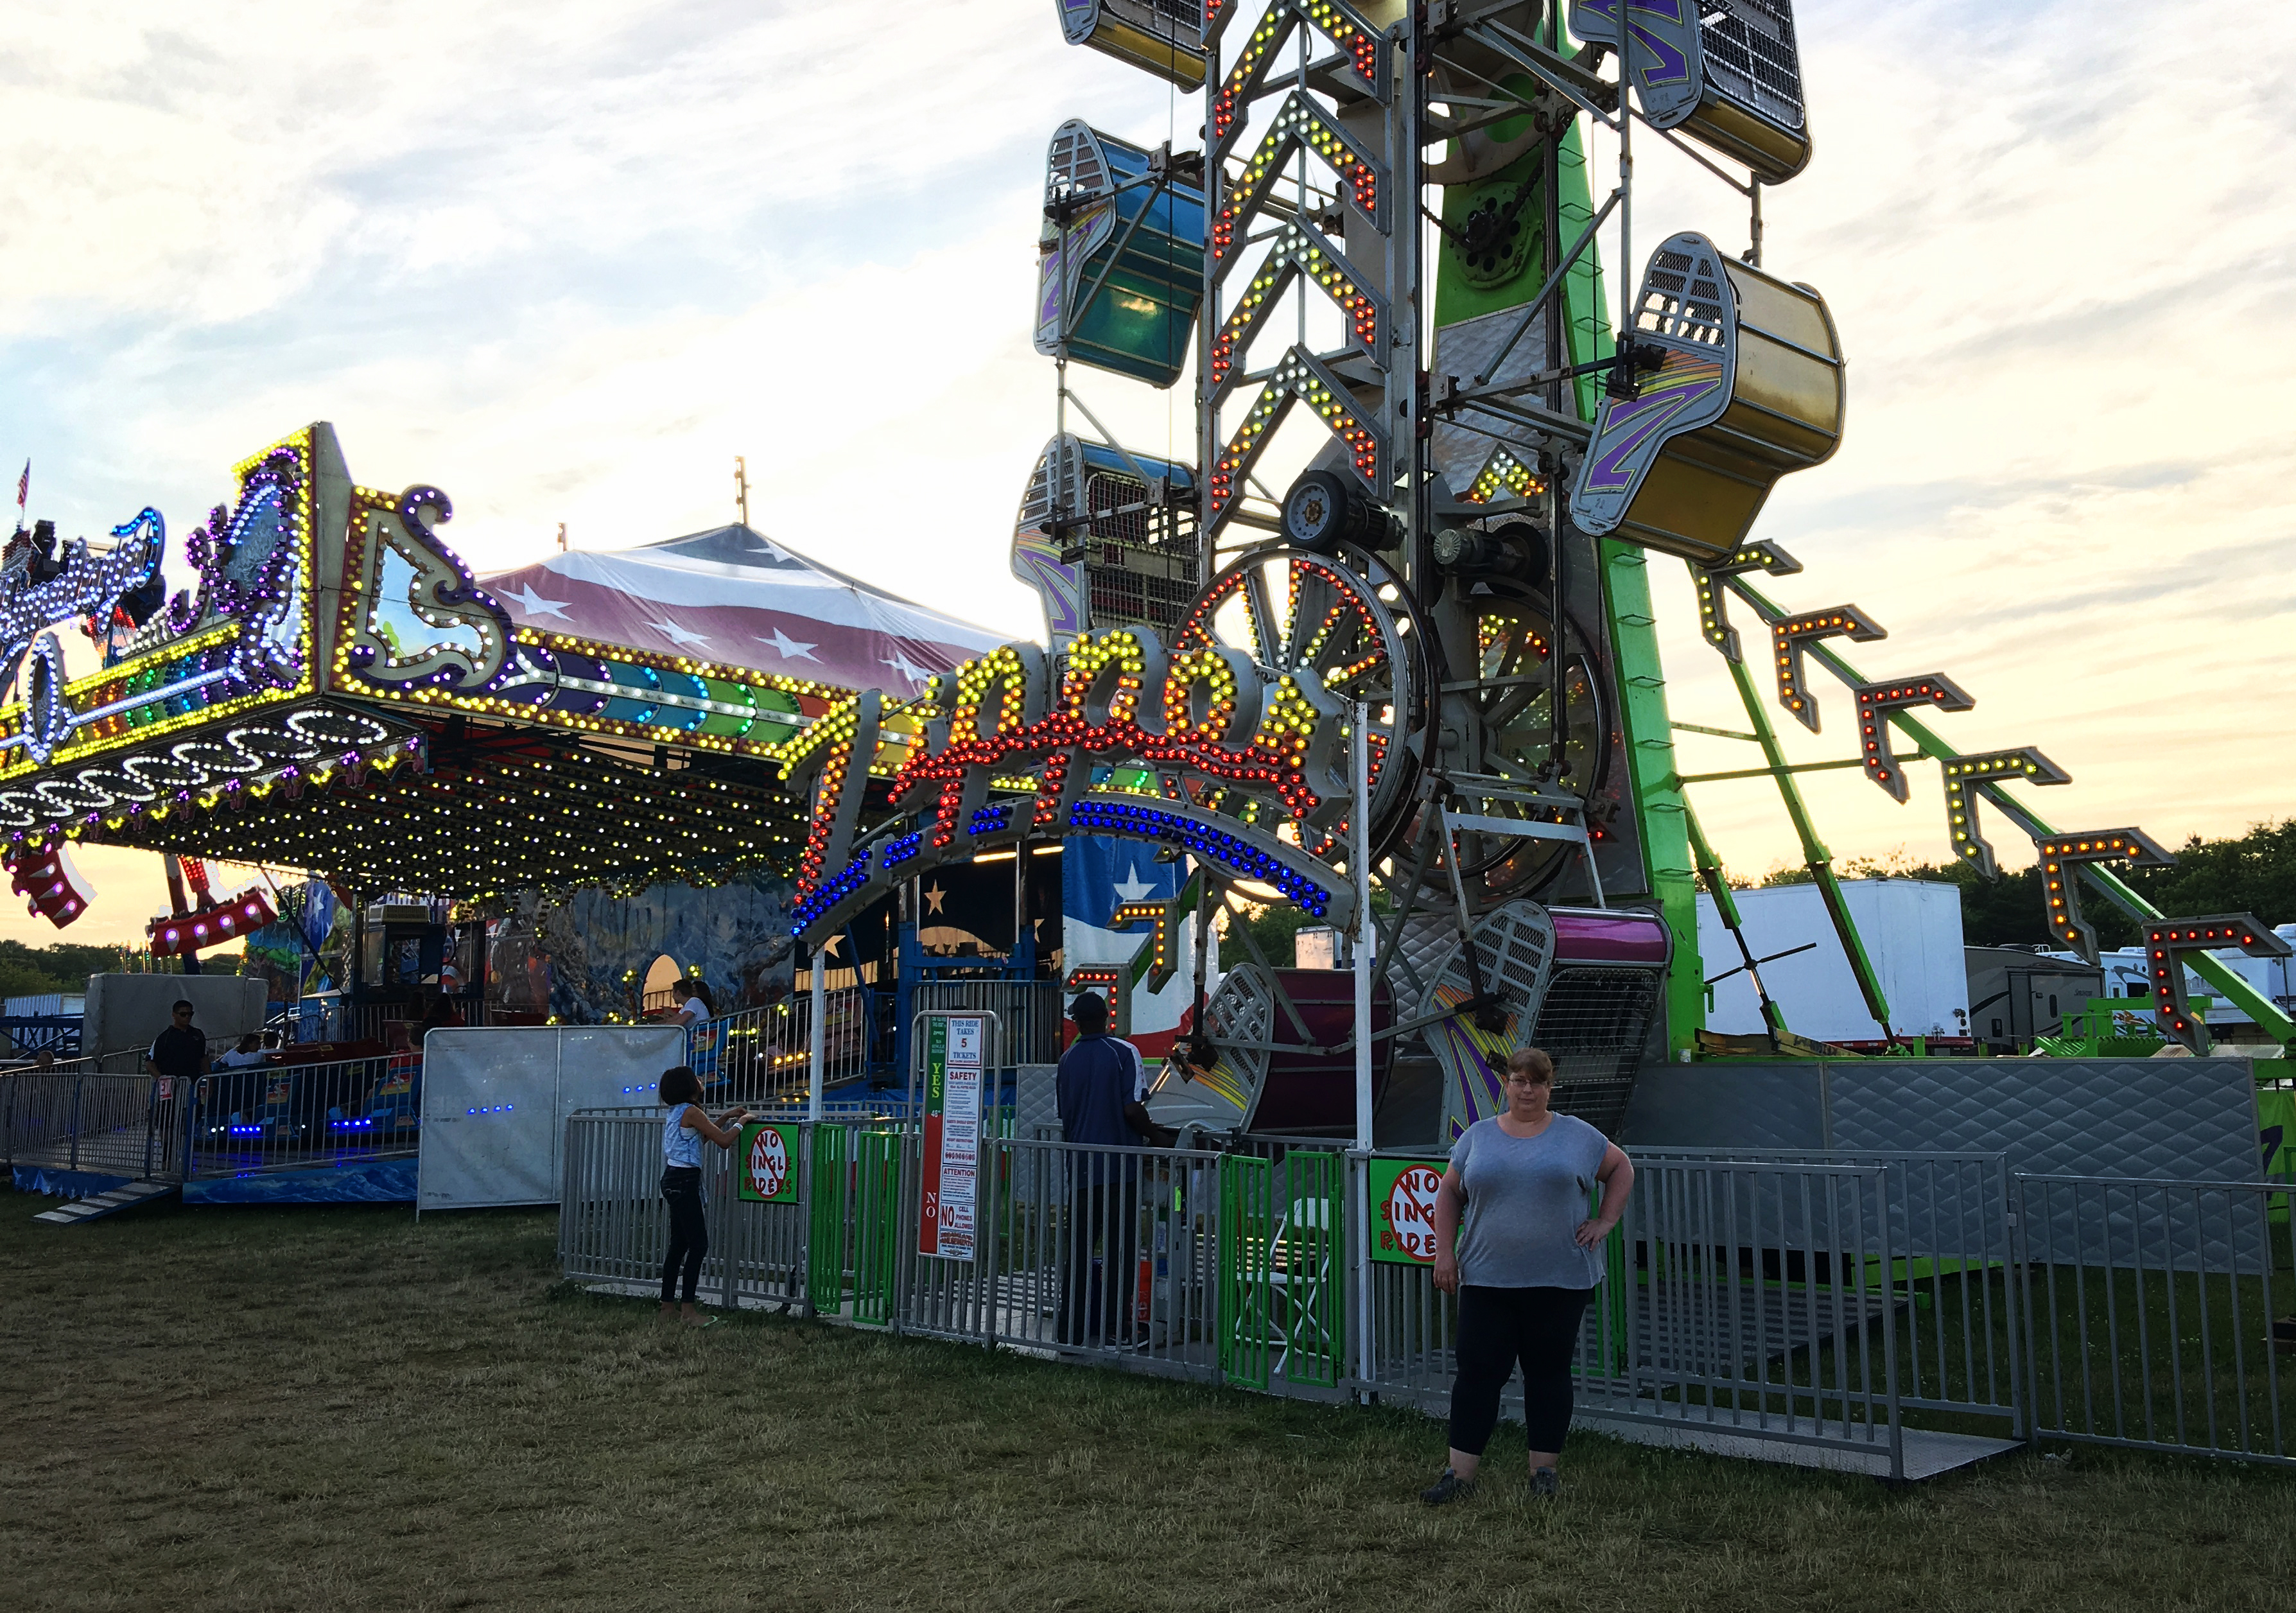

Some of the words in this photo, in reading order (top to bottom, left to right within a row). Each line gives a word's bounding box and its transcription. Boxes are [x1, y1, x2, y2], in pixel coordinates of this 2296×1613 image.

[961, 1038, 967, 1048] 5
[932, 1063, 942, 1098] YES
[950, 1071, 977, 1081] SAFETY
[760, 1133, 779, 1148] NO
[745, 1153, 792, 1172] SINGLE
[943, 1167, 975, 1177] ATTENTION
[744, 1176, 792, 1195] RIDERS
[1405, 1172, 1439, 1194] NO
[926, 1192, 937, 1218] NO
[1380, 1200, 1436, 1223] SING
[941, 1205, 955, 1227] NO
[955, 1214, 972, 1222] PHONES
[1380, 1230, 1436, 1254] RIDE
